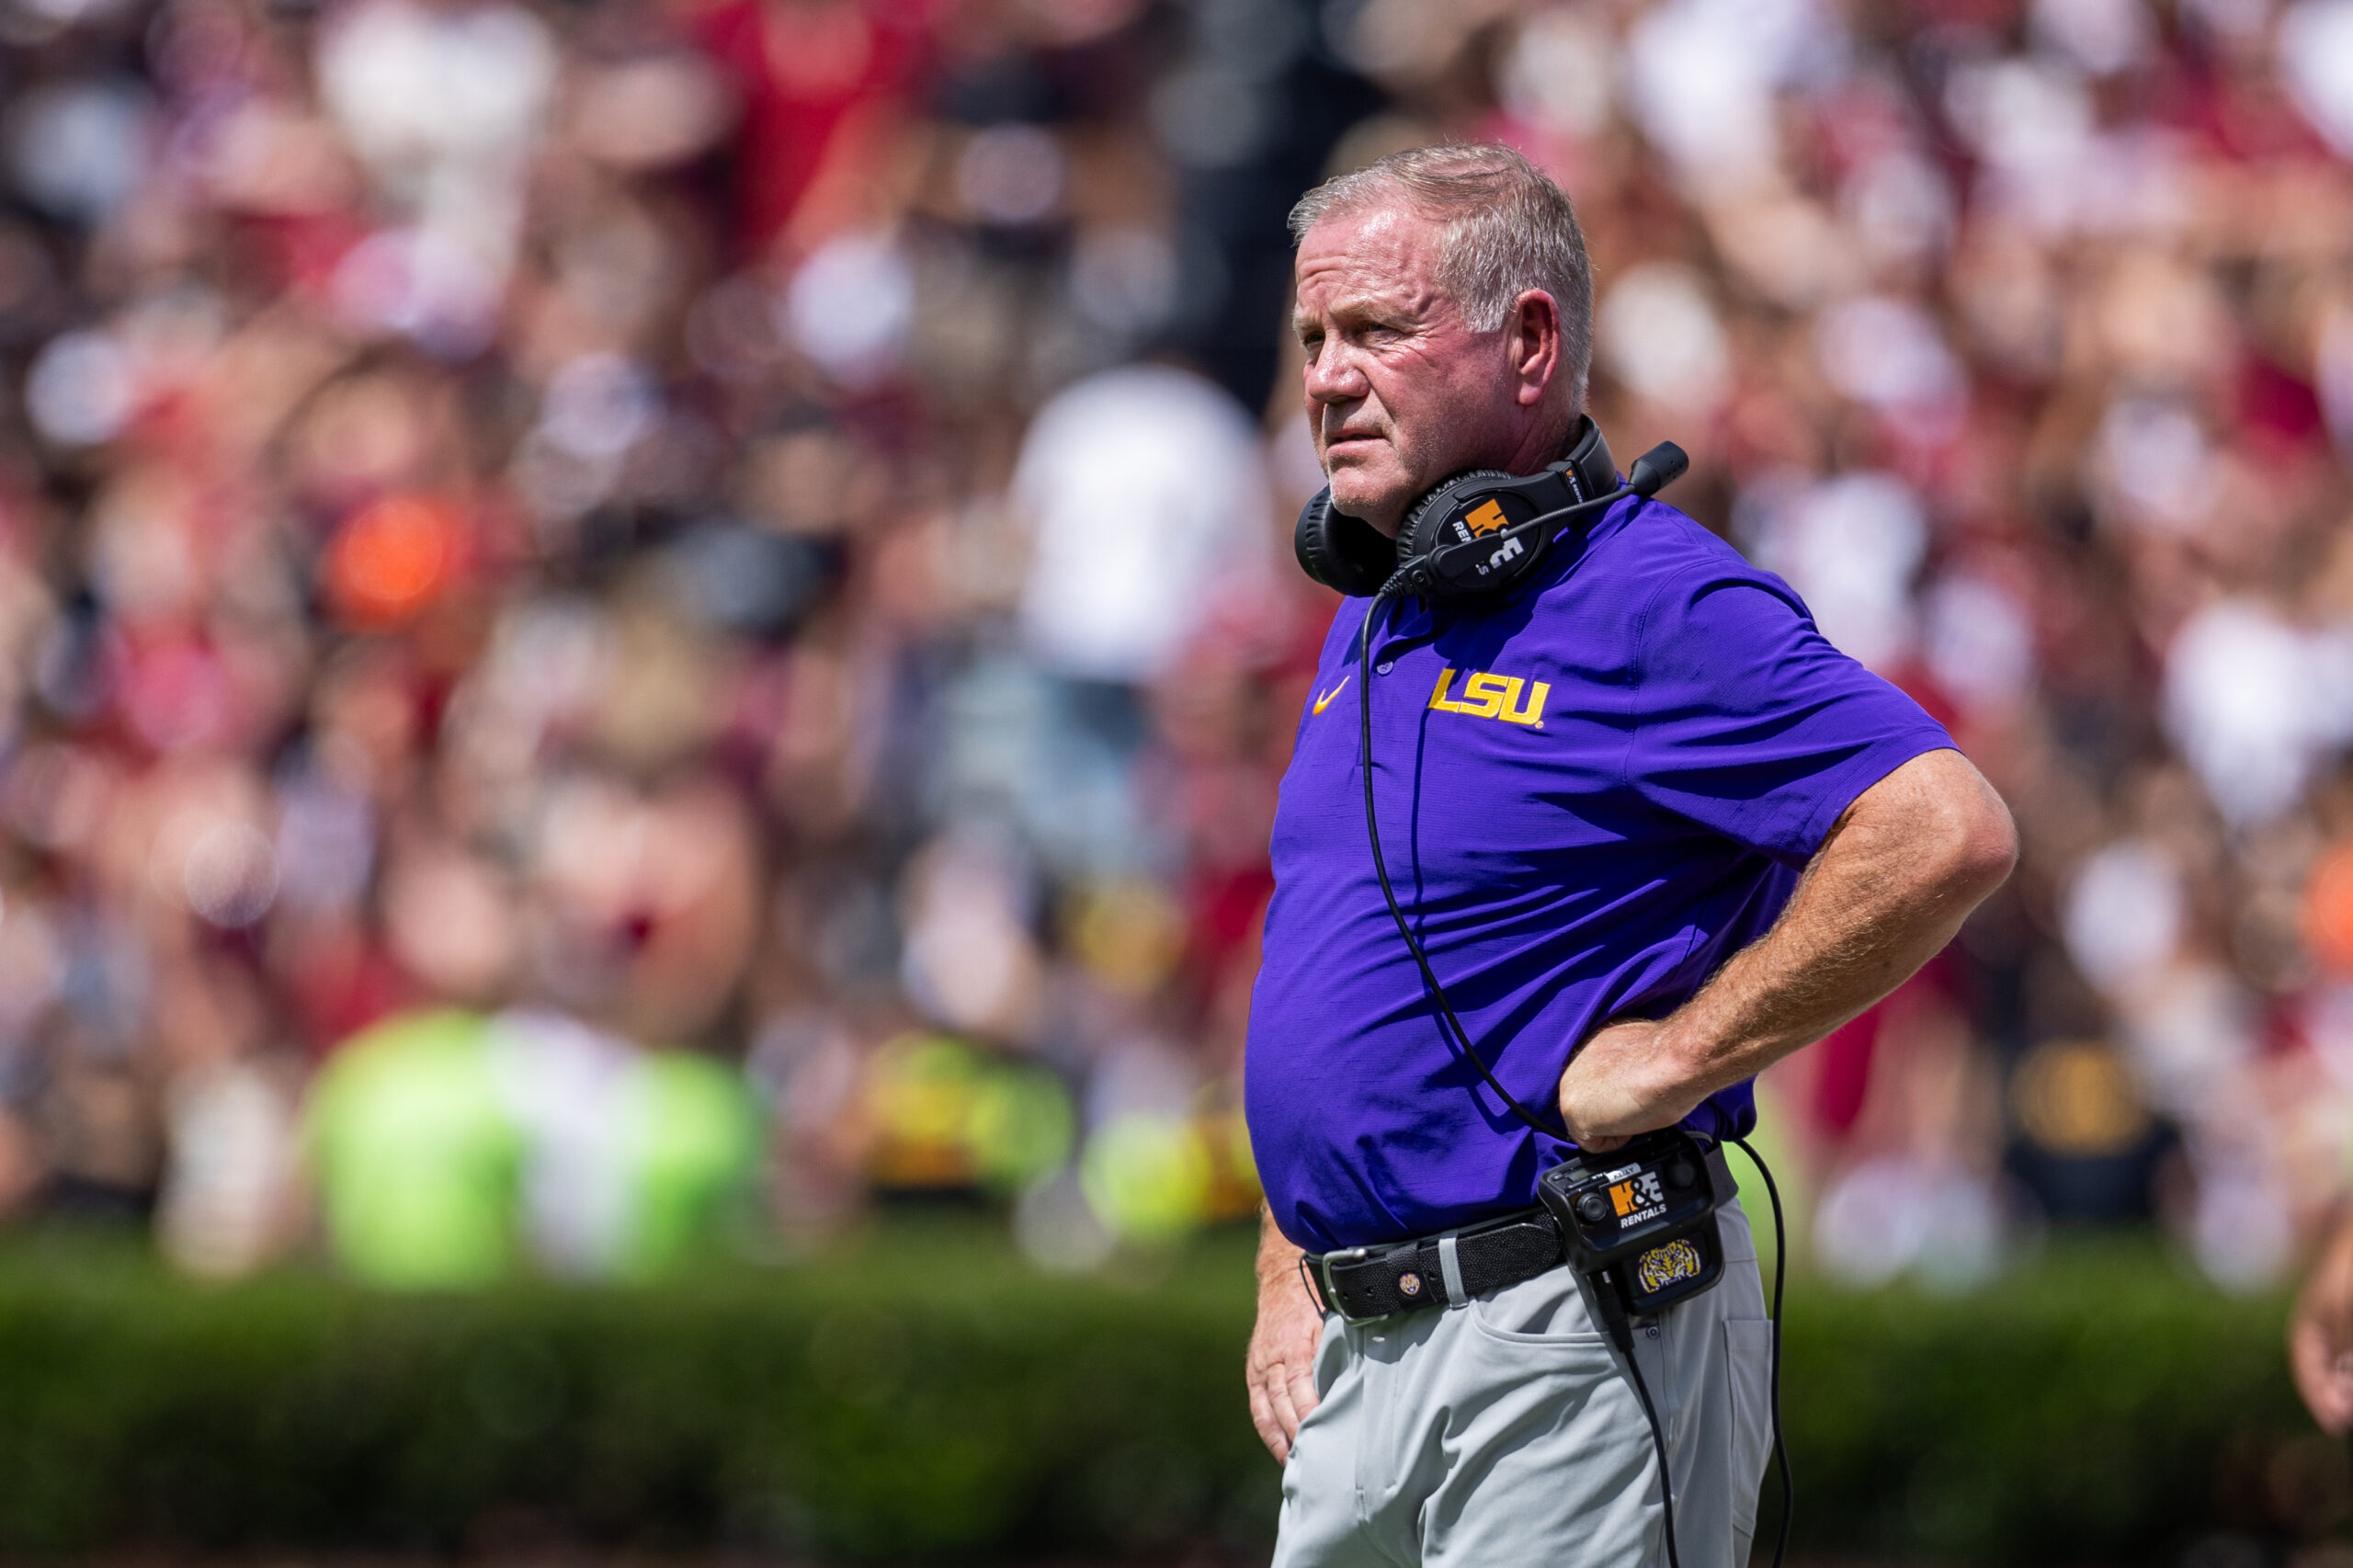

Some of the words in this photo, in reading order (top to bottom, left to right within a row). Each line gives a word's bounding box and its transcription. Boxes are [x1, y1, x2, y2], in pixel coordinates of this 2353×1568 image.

[1427, 667, 1551, 724] LSU
[1608, 1171, 1664, 1217] H&E
[1620, 1204, 1666, 1229] RENTALS
